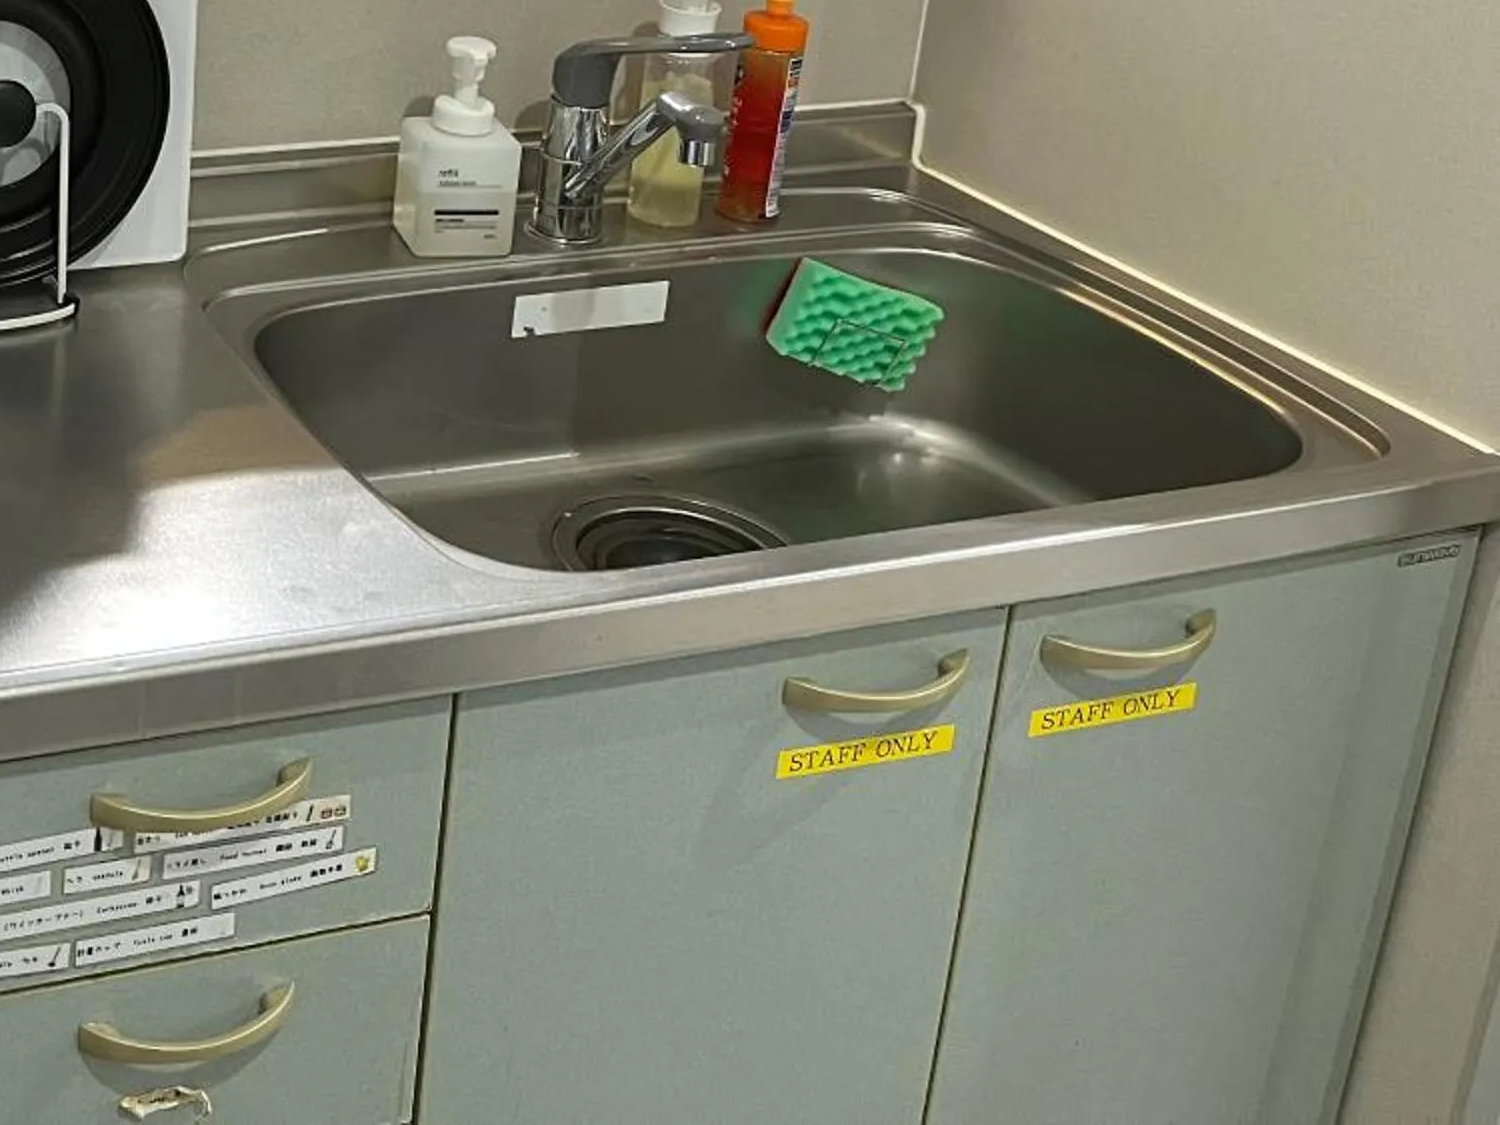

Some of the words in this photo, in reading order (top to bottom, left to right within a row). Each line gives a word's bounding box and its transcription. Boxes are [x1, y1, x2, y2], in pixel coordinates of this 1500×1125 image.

[1041, 701, 1115, 730] STAFF
[1123, 688, 1180, 716] ONLY
[789, 742, 867, 772] STAFF
[875, 730, 938, 758] ONLY
